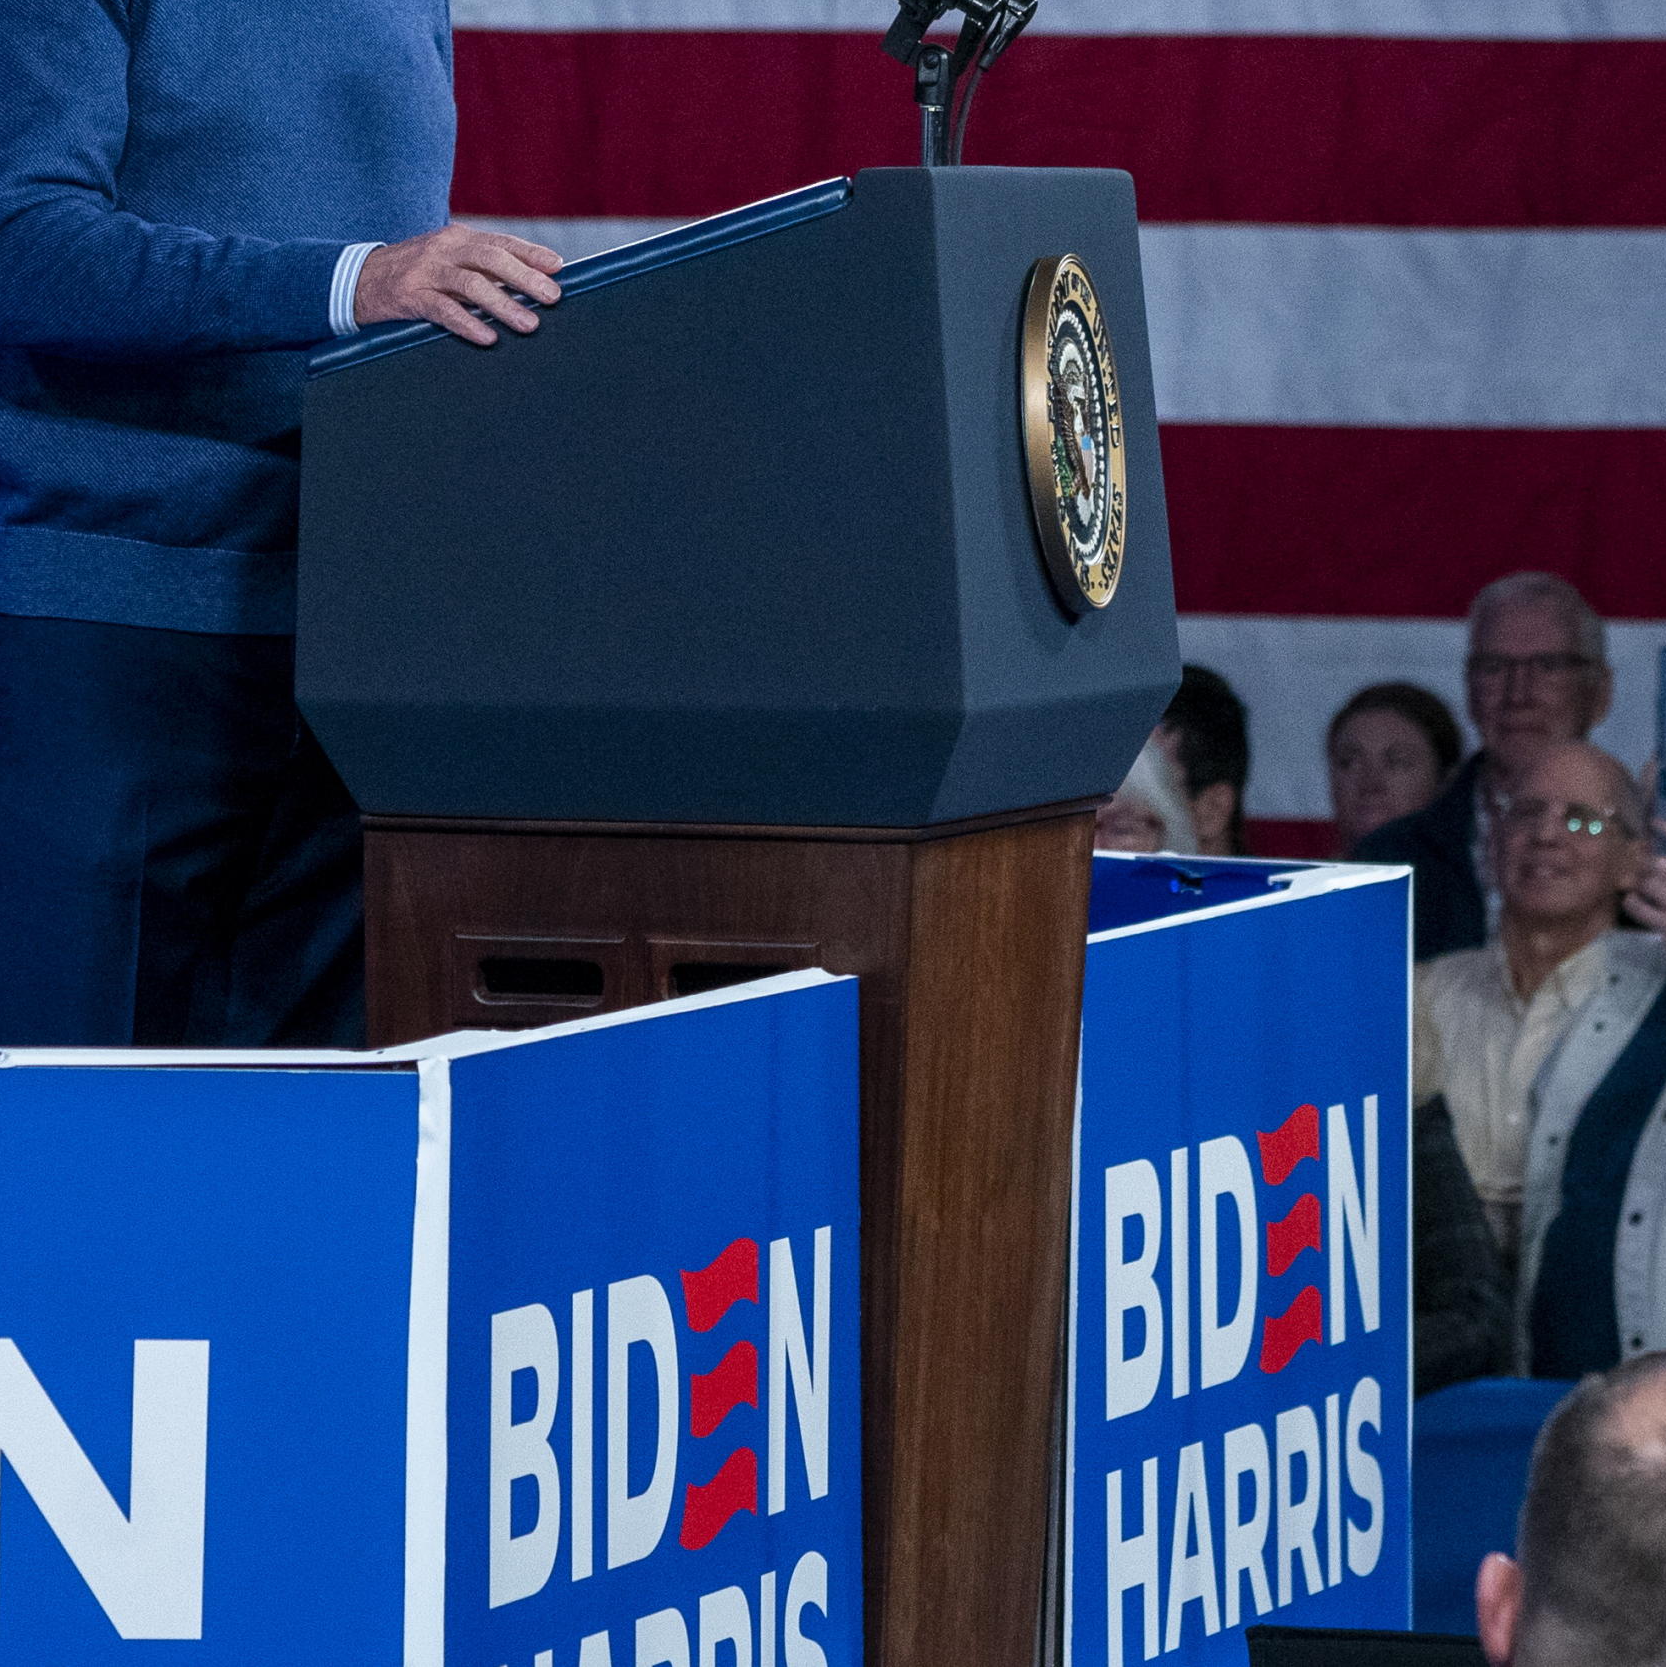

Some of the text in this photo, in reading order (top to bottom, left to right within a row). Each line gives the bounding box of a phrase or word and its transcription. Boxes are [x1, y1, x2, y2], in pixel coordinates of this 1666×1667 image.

[1093, 307, 1120, 448] UNITED
[1102, 483, 1123, 590] STATES
[1105, 1094, 1381, 1421] BIDEN
[489, 1225, 831, 1609] BIDEN
[1106, 1377, 1384, 1667] HARRIS
